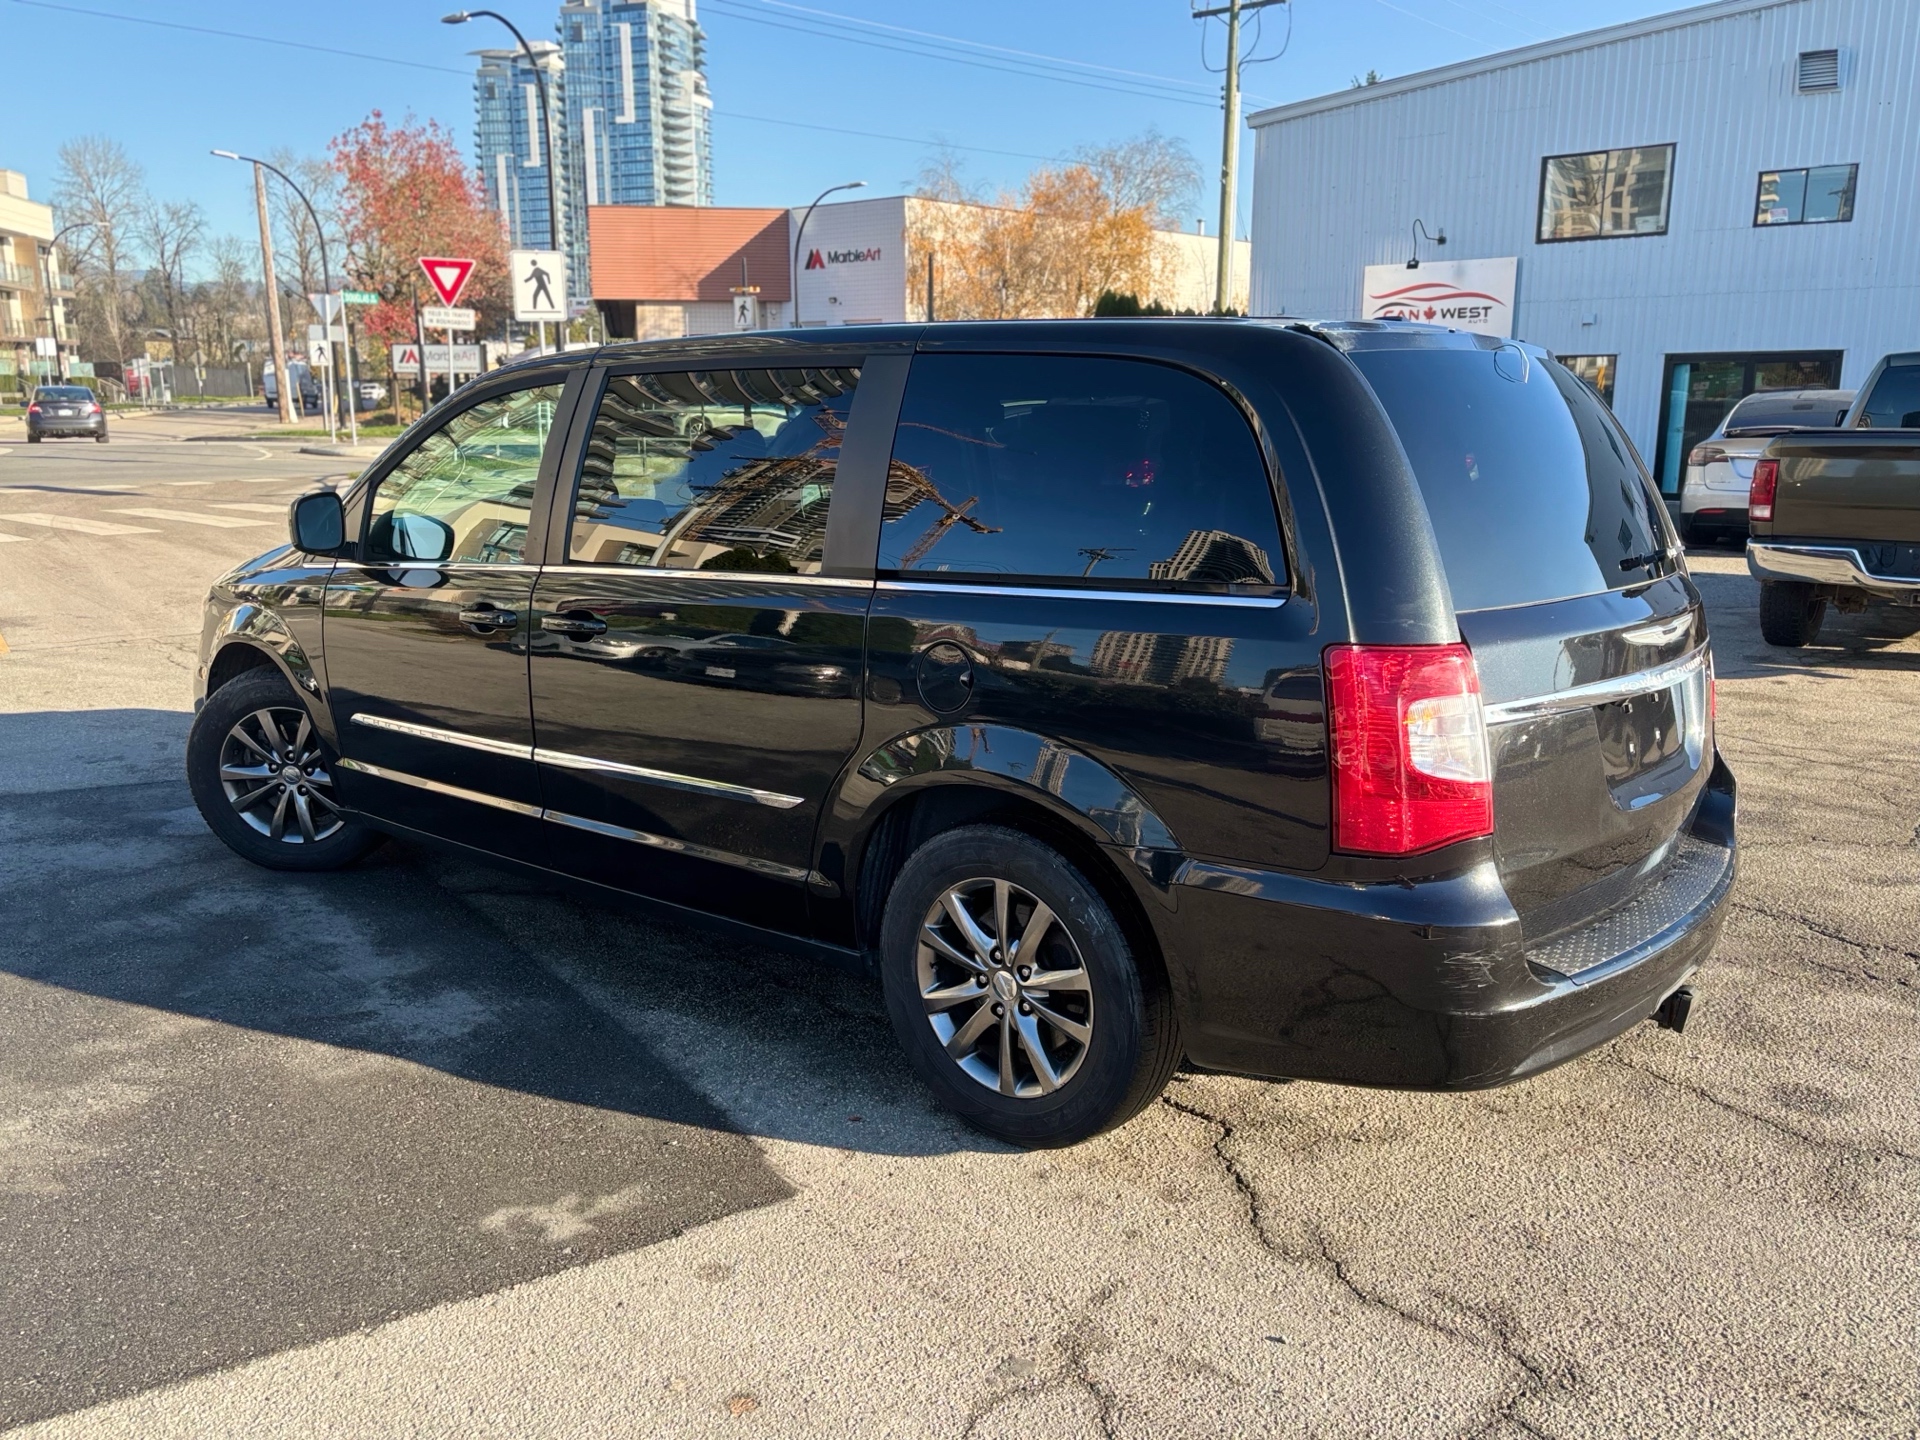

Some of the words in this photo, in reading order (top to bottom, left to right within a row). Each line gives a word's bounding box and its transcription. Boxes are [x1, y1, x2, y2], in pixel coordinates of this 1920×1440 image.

[827, 247, 881, 264] MarbleArt
[1440, 306, 1492, 319] WEST
[362, 716, 452, 742] CHRYSLER
